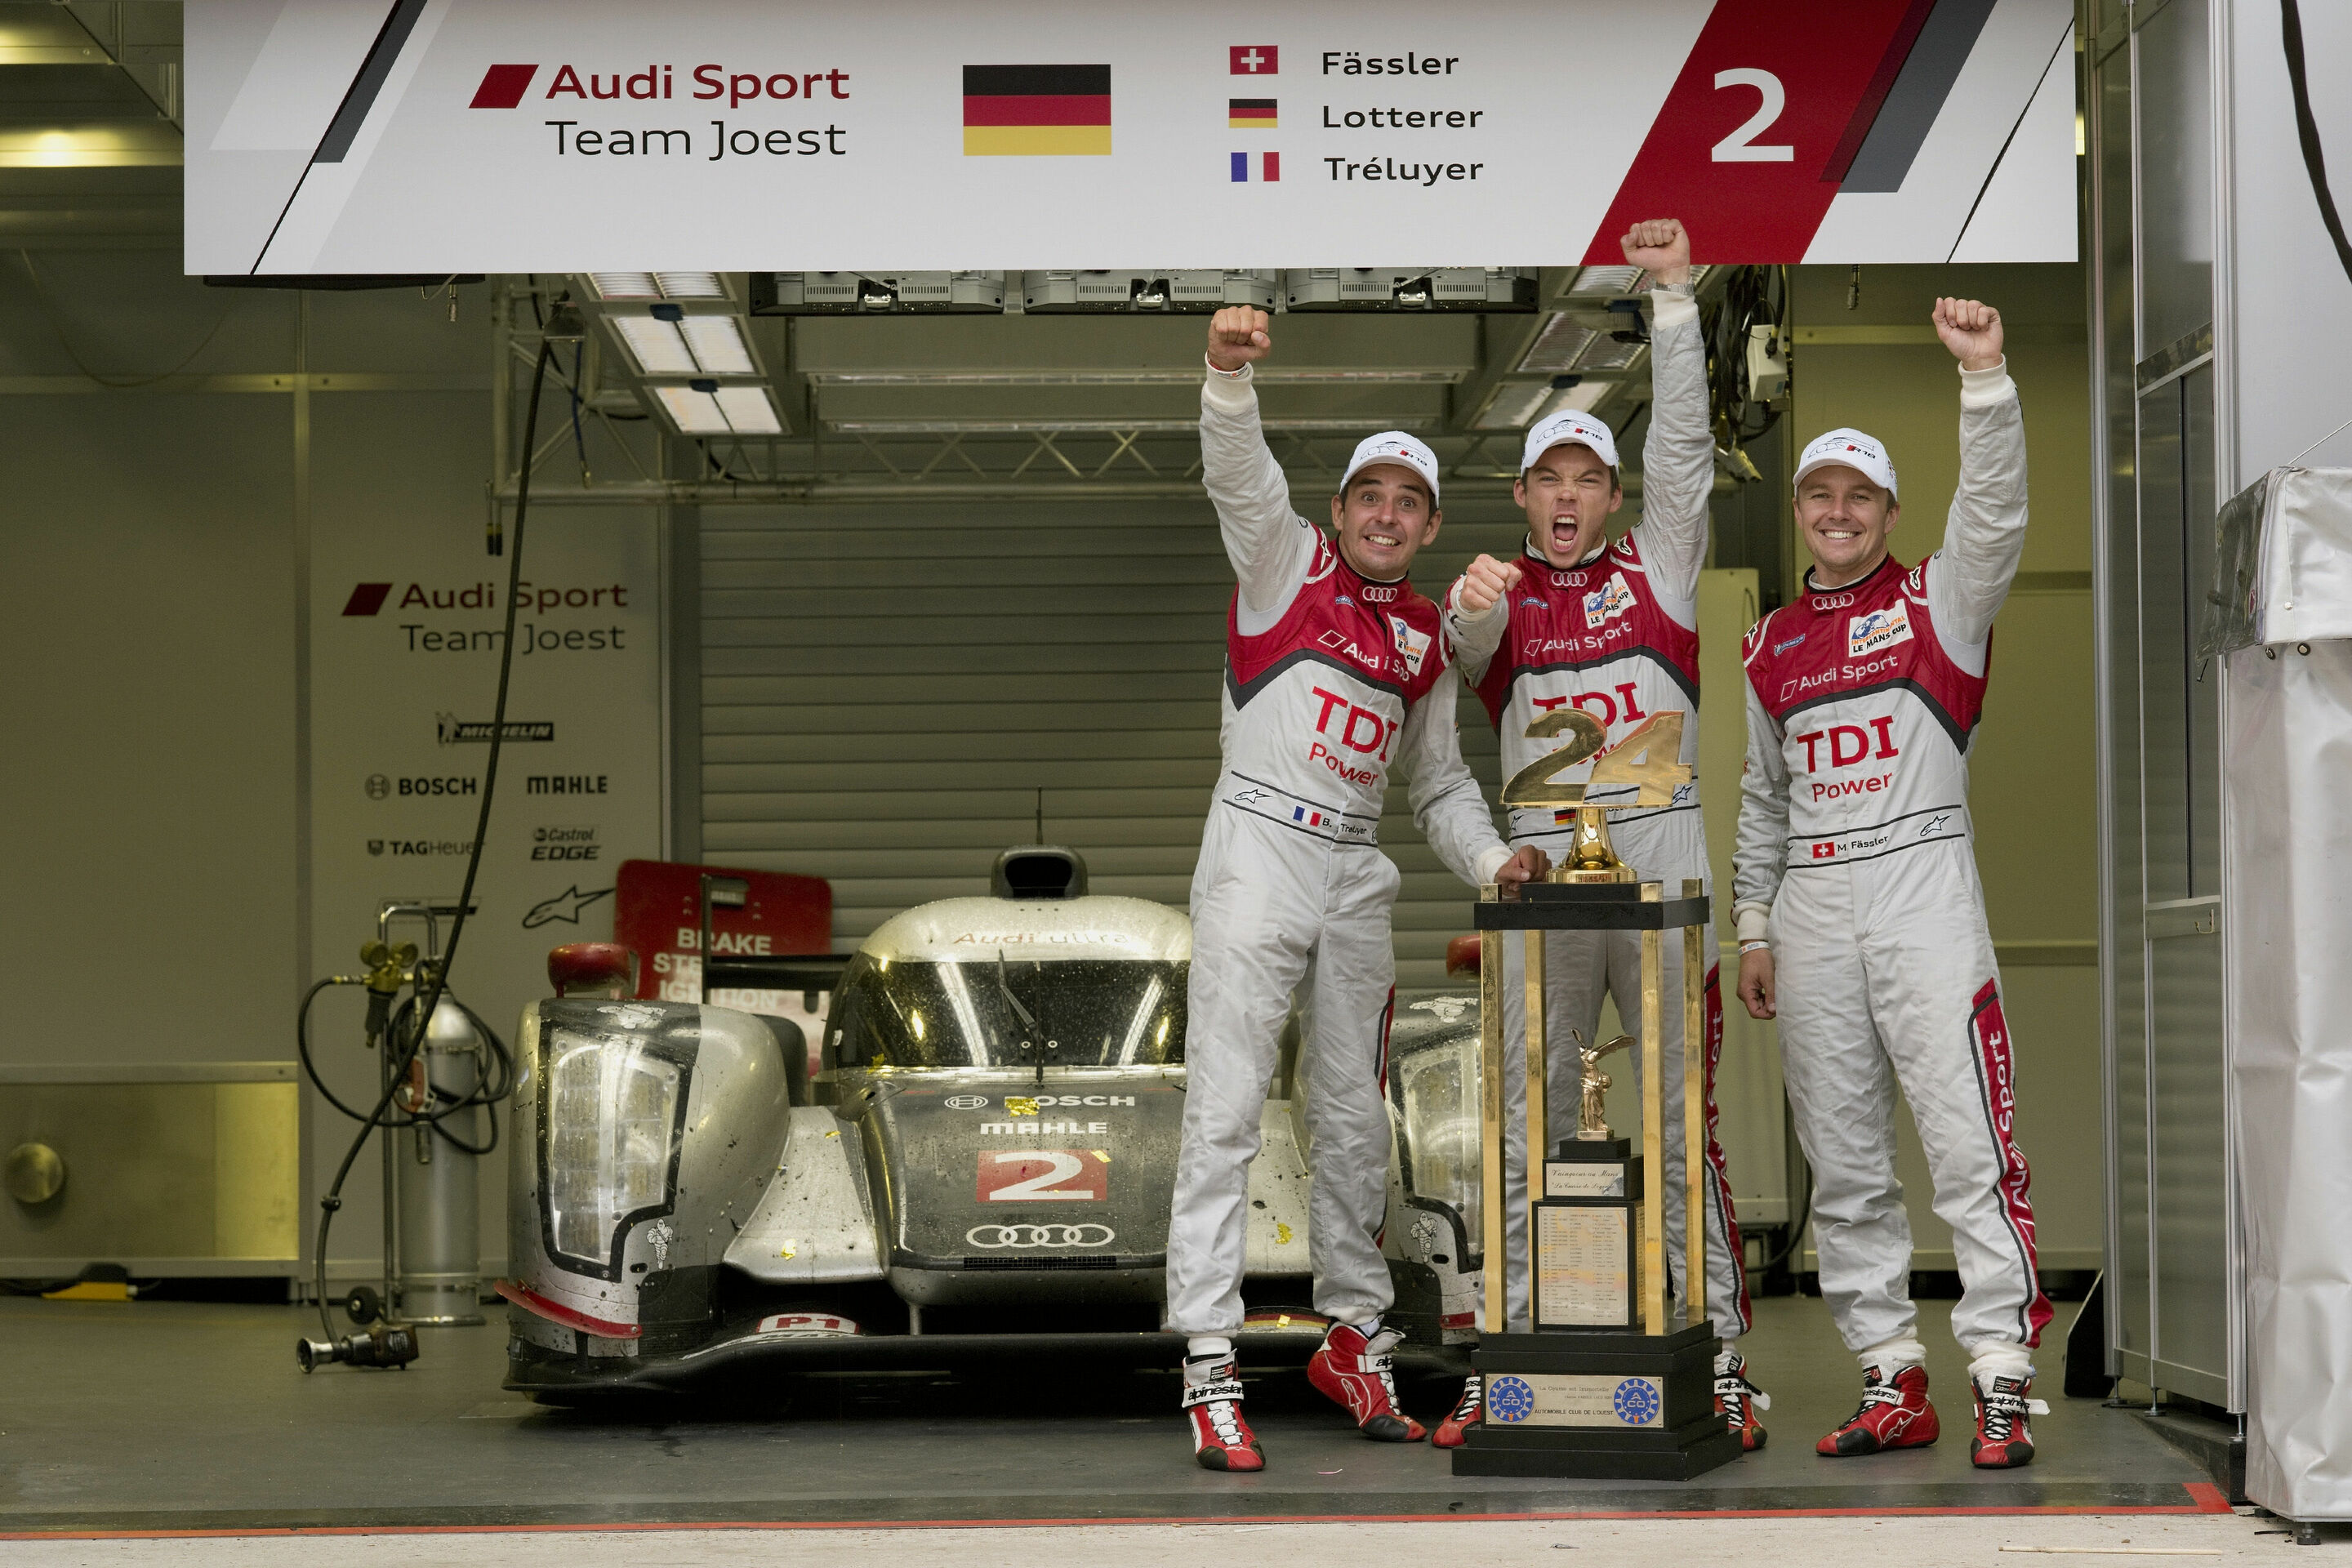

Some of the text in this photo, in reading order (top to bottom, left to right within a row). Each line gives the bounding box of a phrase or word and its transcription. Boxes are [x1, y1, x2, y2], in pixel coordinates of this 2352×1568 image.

[1321, 51, 1459, 76] Fässler
[546, 64, 850, 109] Audi Sport
[1322, 105, 1484, 129] Lotterer
[1711, 68, 1794, 163] 2
[546, 120, 847, 161] Team Joest
[1324, 157, 1484, 187] Tréluyer
[1853, 446, 1876, 459] R18
[399, 582, 628, 615] Audi Sport
[399, 623, 626, 655] Team Joest
[1542, 621, 1633, 652] Audi Sport
[1853, 644, 1864, 653] LE
[1343, 642, 1389, 670] Audi
[1392, 659, 1410, 682] Spo
[1799, 655, 1899, 692] Audi Sport
[1312, 685, 1399, 764] TDI
[1500, 707, 1693, 804] 24
[1796, 715, 1900, 774] TDI
[1308, 742, 1379, 788] Power
[399, 777, 477, 795] BOSCH
[527, 776, 608, 795] MAHLE
[1811, 772, 1894, 803] Power
[548, 827, 595, 842] Castrol
[1322, 817, 1332, 828] B.
[390, 840, 487, 856] TAGHeue
[531, 845, 601, 861] EDGE
[1851, 836, 1889, 849] Fässler
[953, 933, 1035, 944] Audi
[1989, 1031, 2015, 1133] Sport
[1004, 1095, 1135, 1107] OSCH
[980, 1122, 1107, 1135] MAHLE
[989, 1151, 1094, 1200] 2
[776, 1316, 840, 1330] P1
[1188, 1384, 1243, 1401] alpinestar
